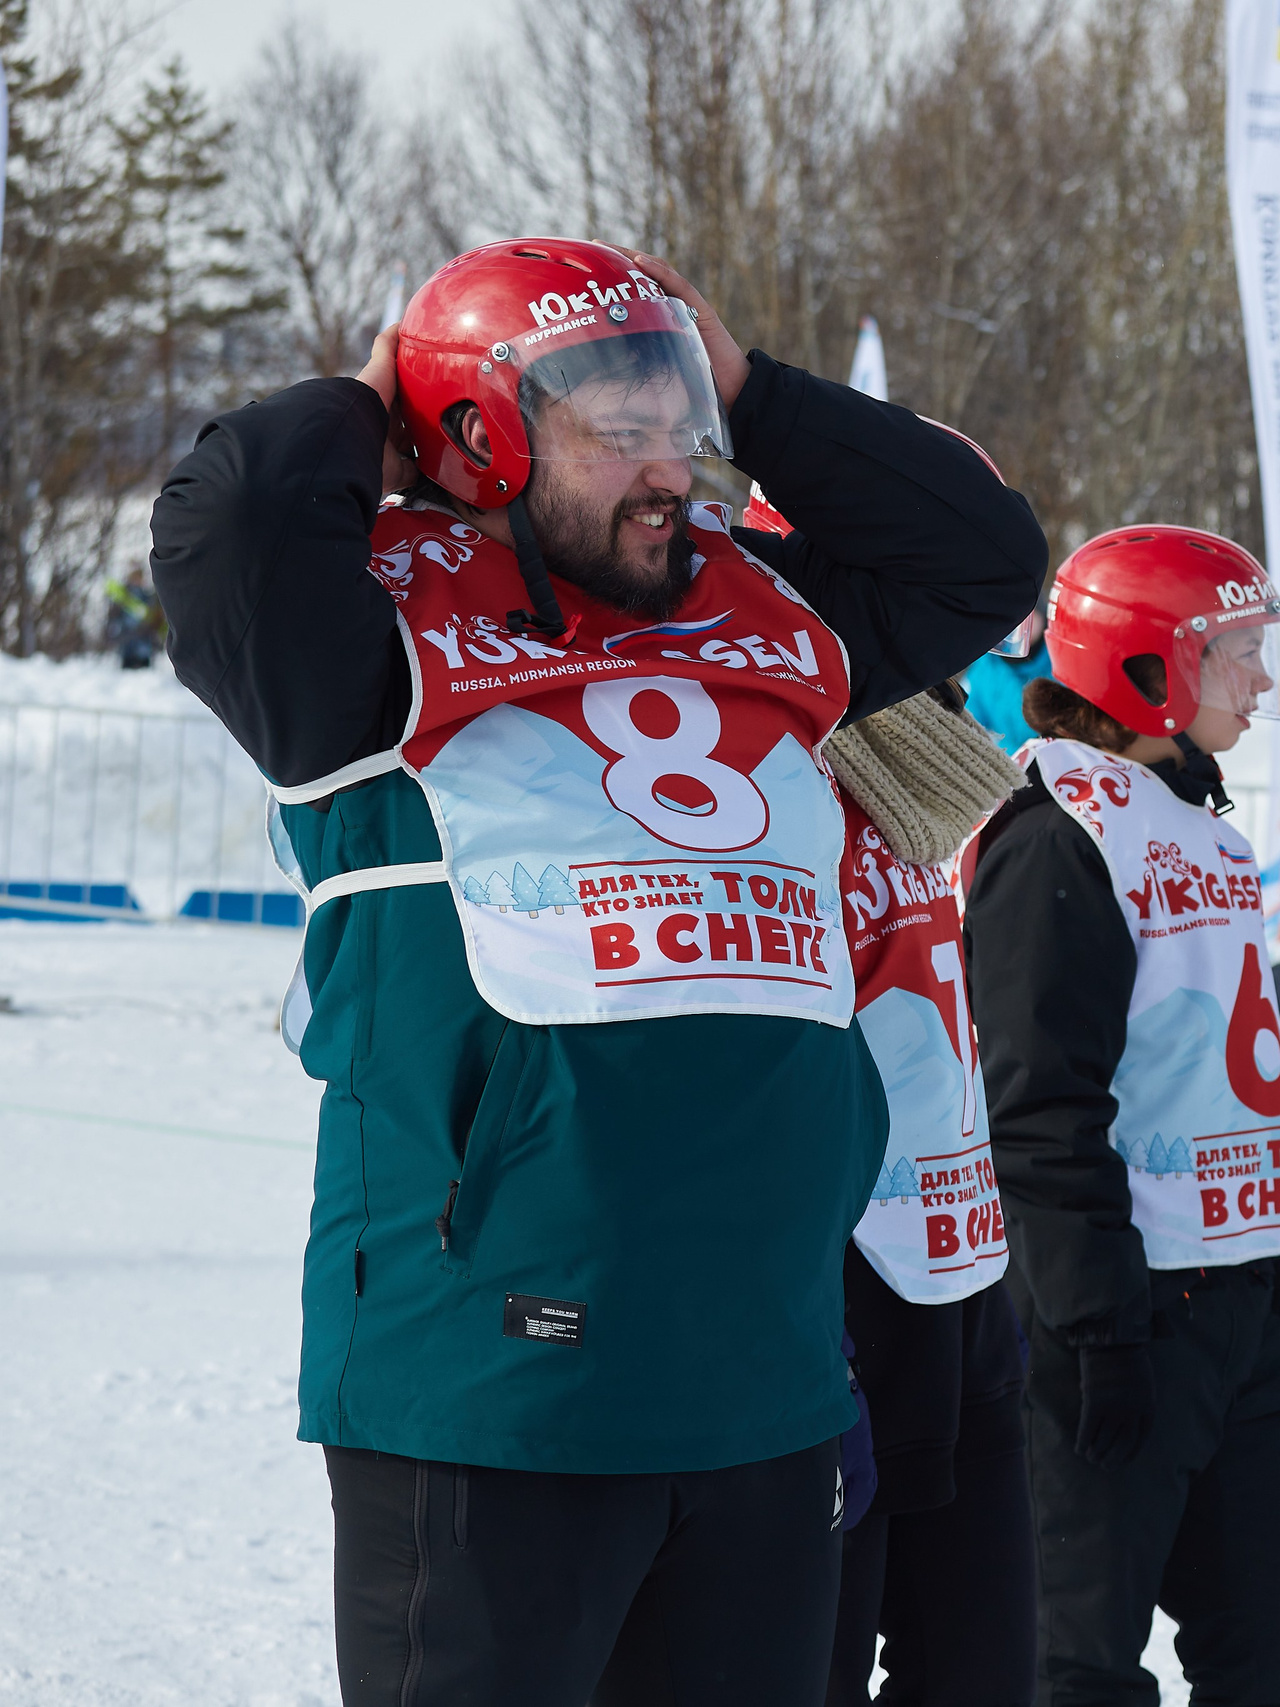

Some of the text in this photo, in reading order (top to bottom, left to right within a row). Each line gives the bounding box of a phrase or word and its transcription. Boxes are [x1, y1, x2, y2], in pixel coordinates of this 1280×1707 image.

[524, 314, 598, 346] МУРМАНСК
[1216, 605, 1267, 623] МУРМАНСК
[451, 658, 637, 693] RUSSIA, MURMANSK REGION
[582, 675, 769, 853] 8
[579, 873, 700, 899] ДЛЯ ТЕХ,
[582, 892, 704, 918] КТО ЗНАЕТ
[590, 913, 828, 974] В СНЕГЕ
[1196, 1142, 1261, 1167] ДЛЯ ТЕХ,
[921, 1168, 961, 1191] ДЛЯ
[1197, 1168, 1226, 1182] КТО
[922, 1192, 956, 1207] КТО
[1200, 1188, 1229, 1228] В
[926, 1214, 960, 1259] В
